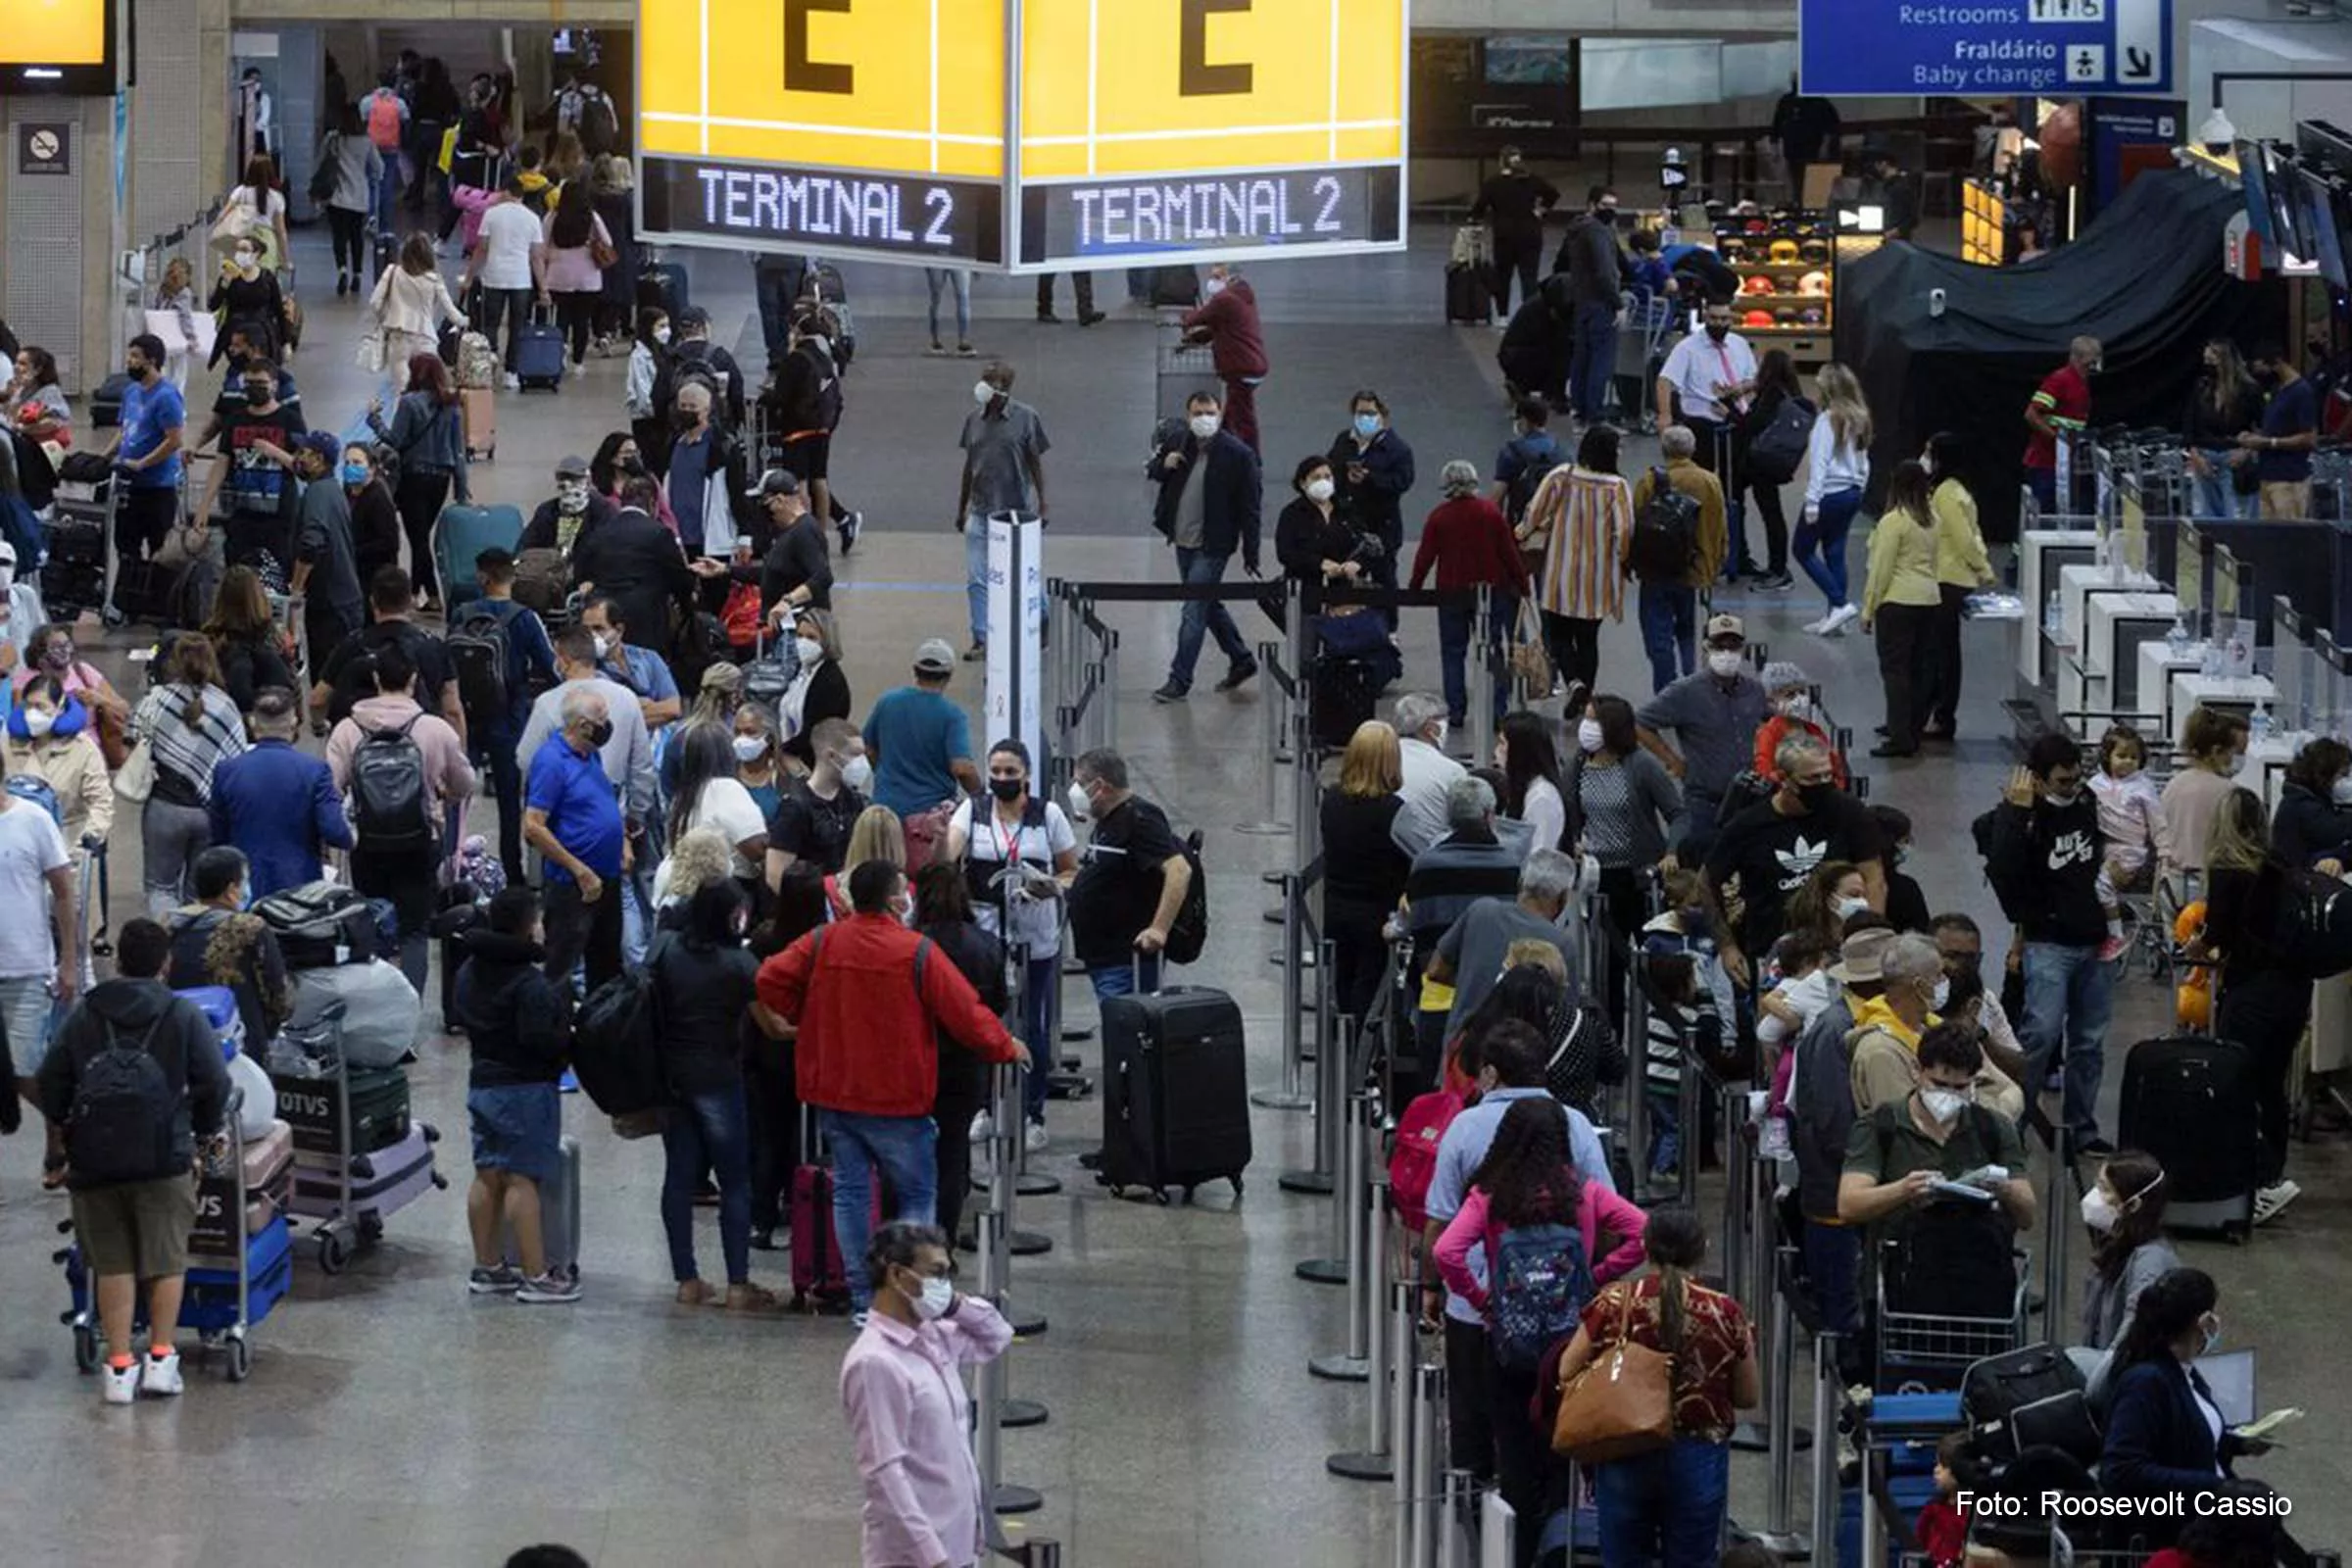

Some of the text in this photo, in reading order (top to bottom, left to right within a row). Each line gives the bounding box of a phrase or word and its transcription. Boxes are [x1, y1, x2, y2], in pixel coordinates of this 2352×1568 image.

[1899, 4, 2020, 24] Restrooms
[1954, 39, 2057, 61] Fraldário
[1913, 65, 2057, 89] Baby change
[697, 168, 954, 245] TERMINAL 2
[1072, 175, 1342, 245] TERMINAL 2
